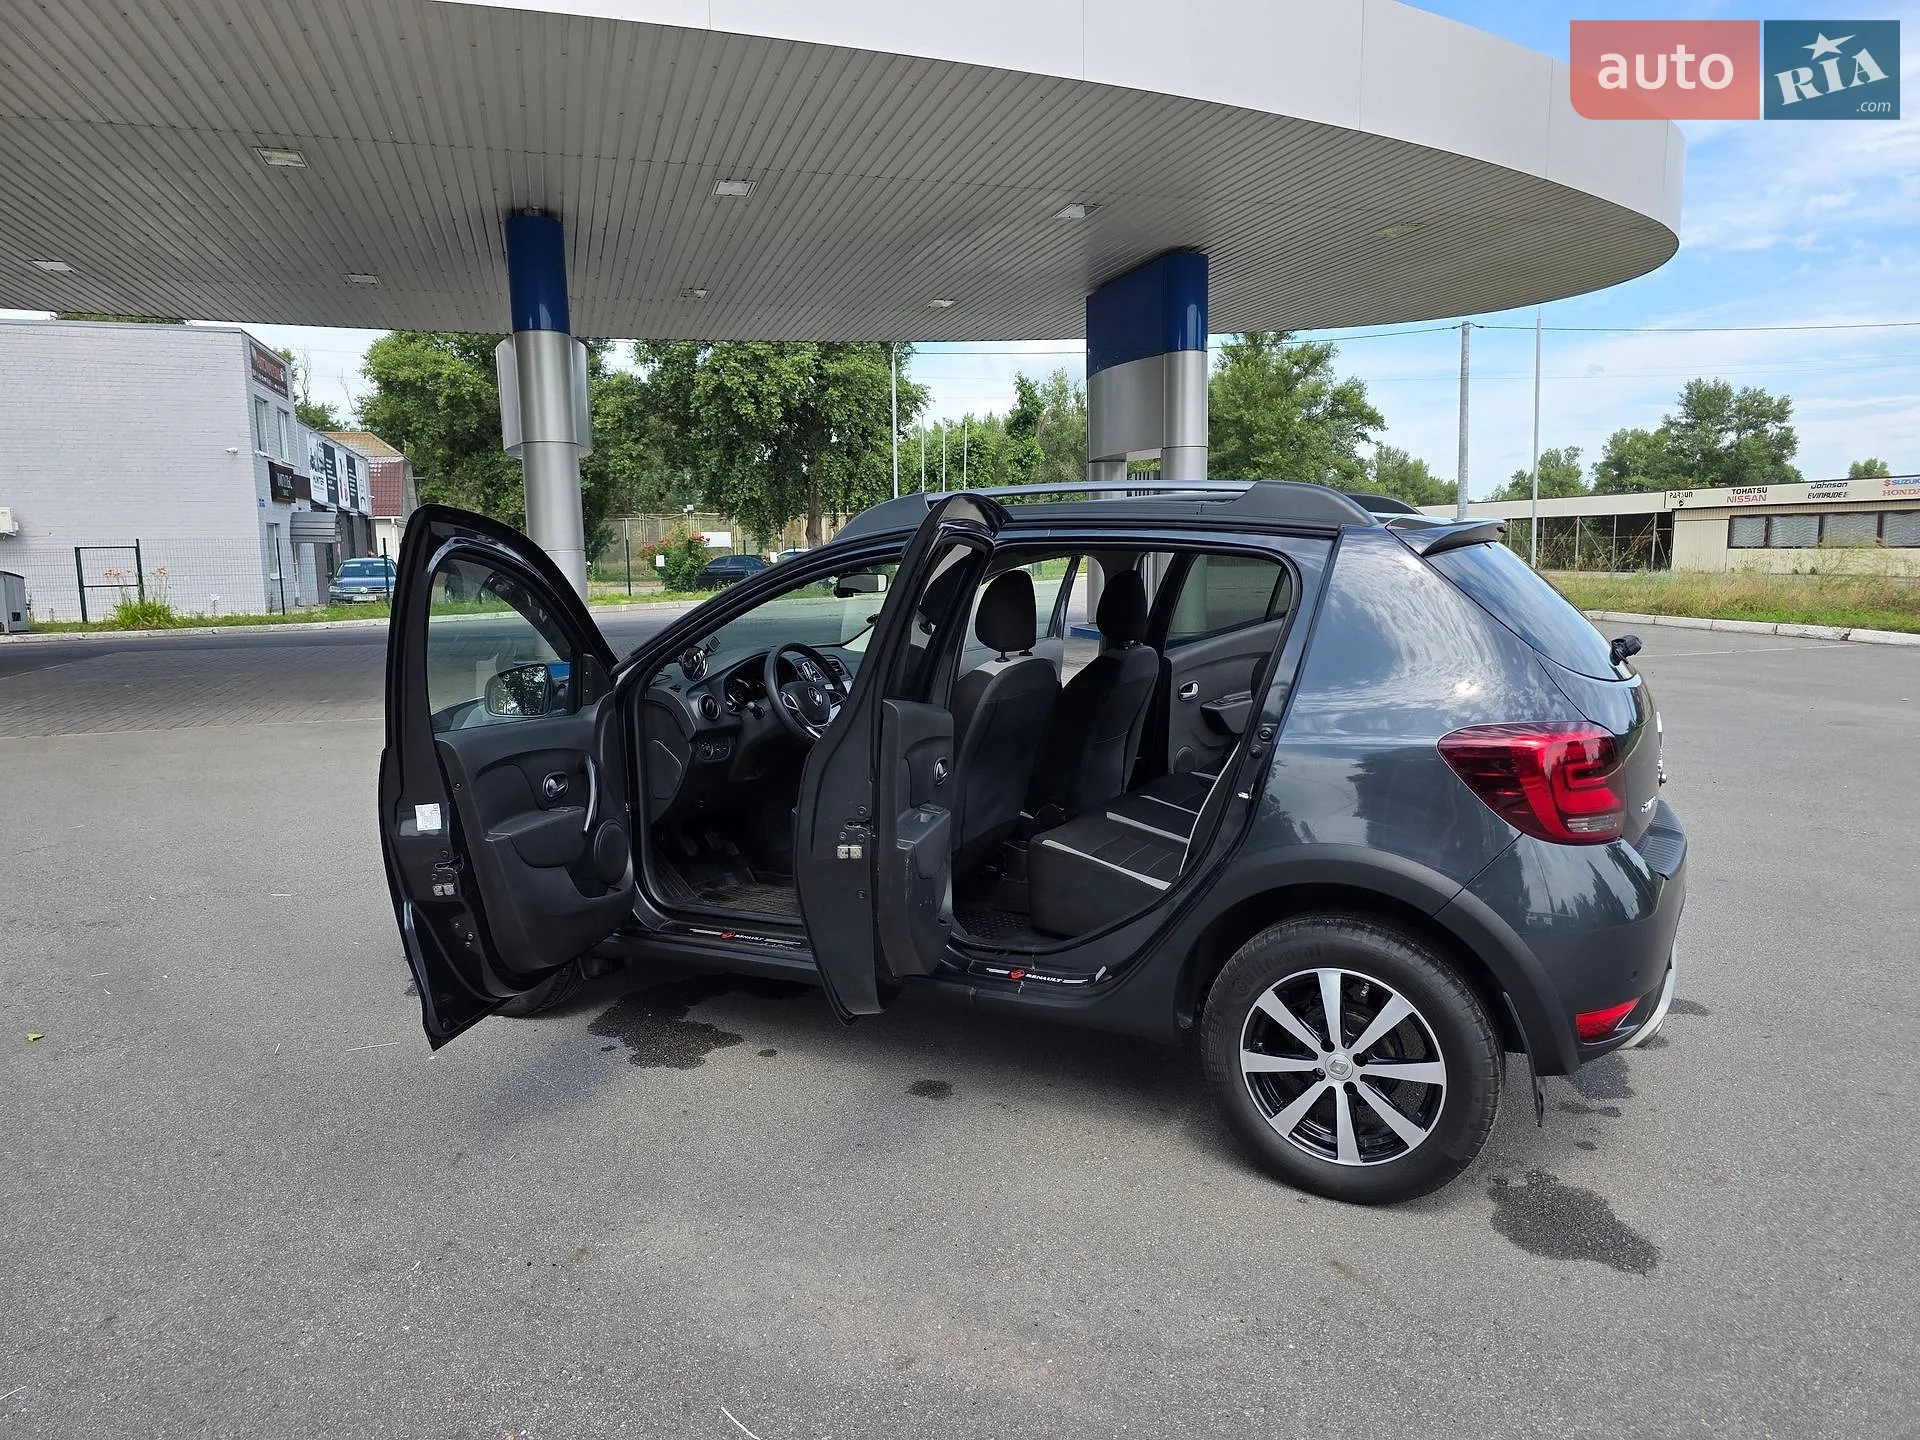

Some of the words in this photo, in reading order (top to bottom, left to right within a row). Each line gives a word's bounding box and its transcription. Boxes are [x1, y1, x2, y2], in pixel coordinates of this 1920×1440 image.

[1731, 486, 1768, 495] TOHATSU
[1810, 482, 1848, 490] Johnson
[1726, 494, 1767, 504] NISSAN
